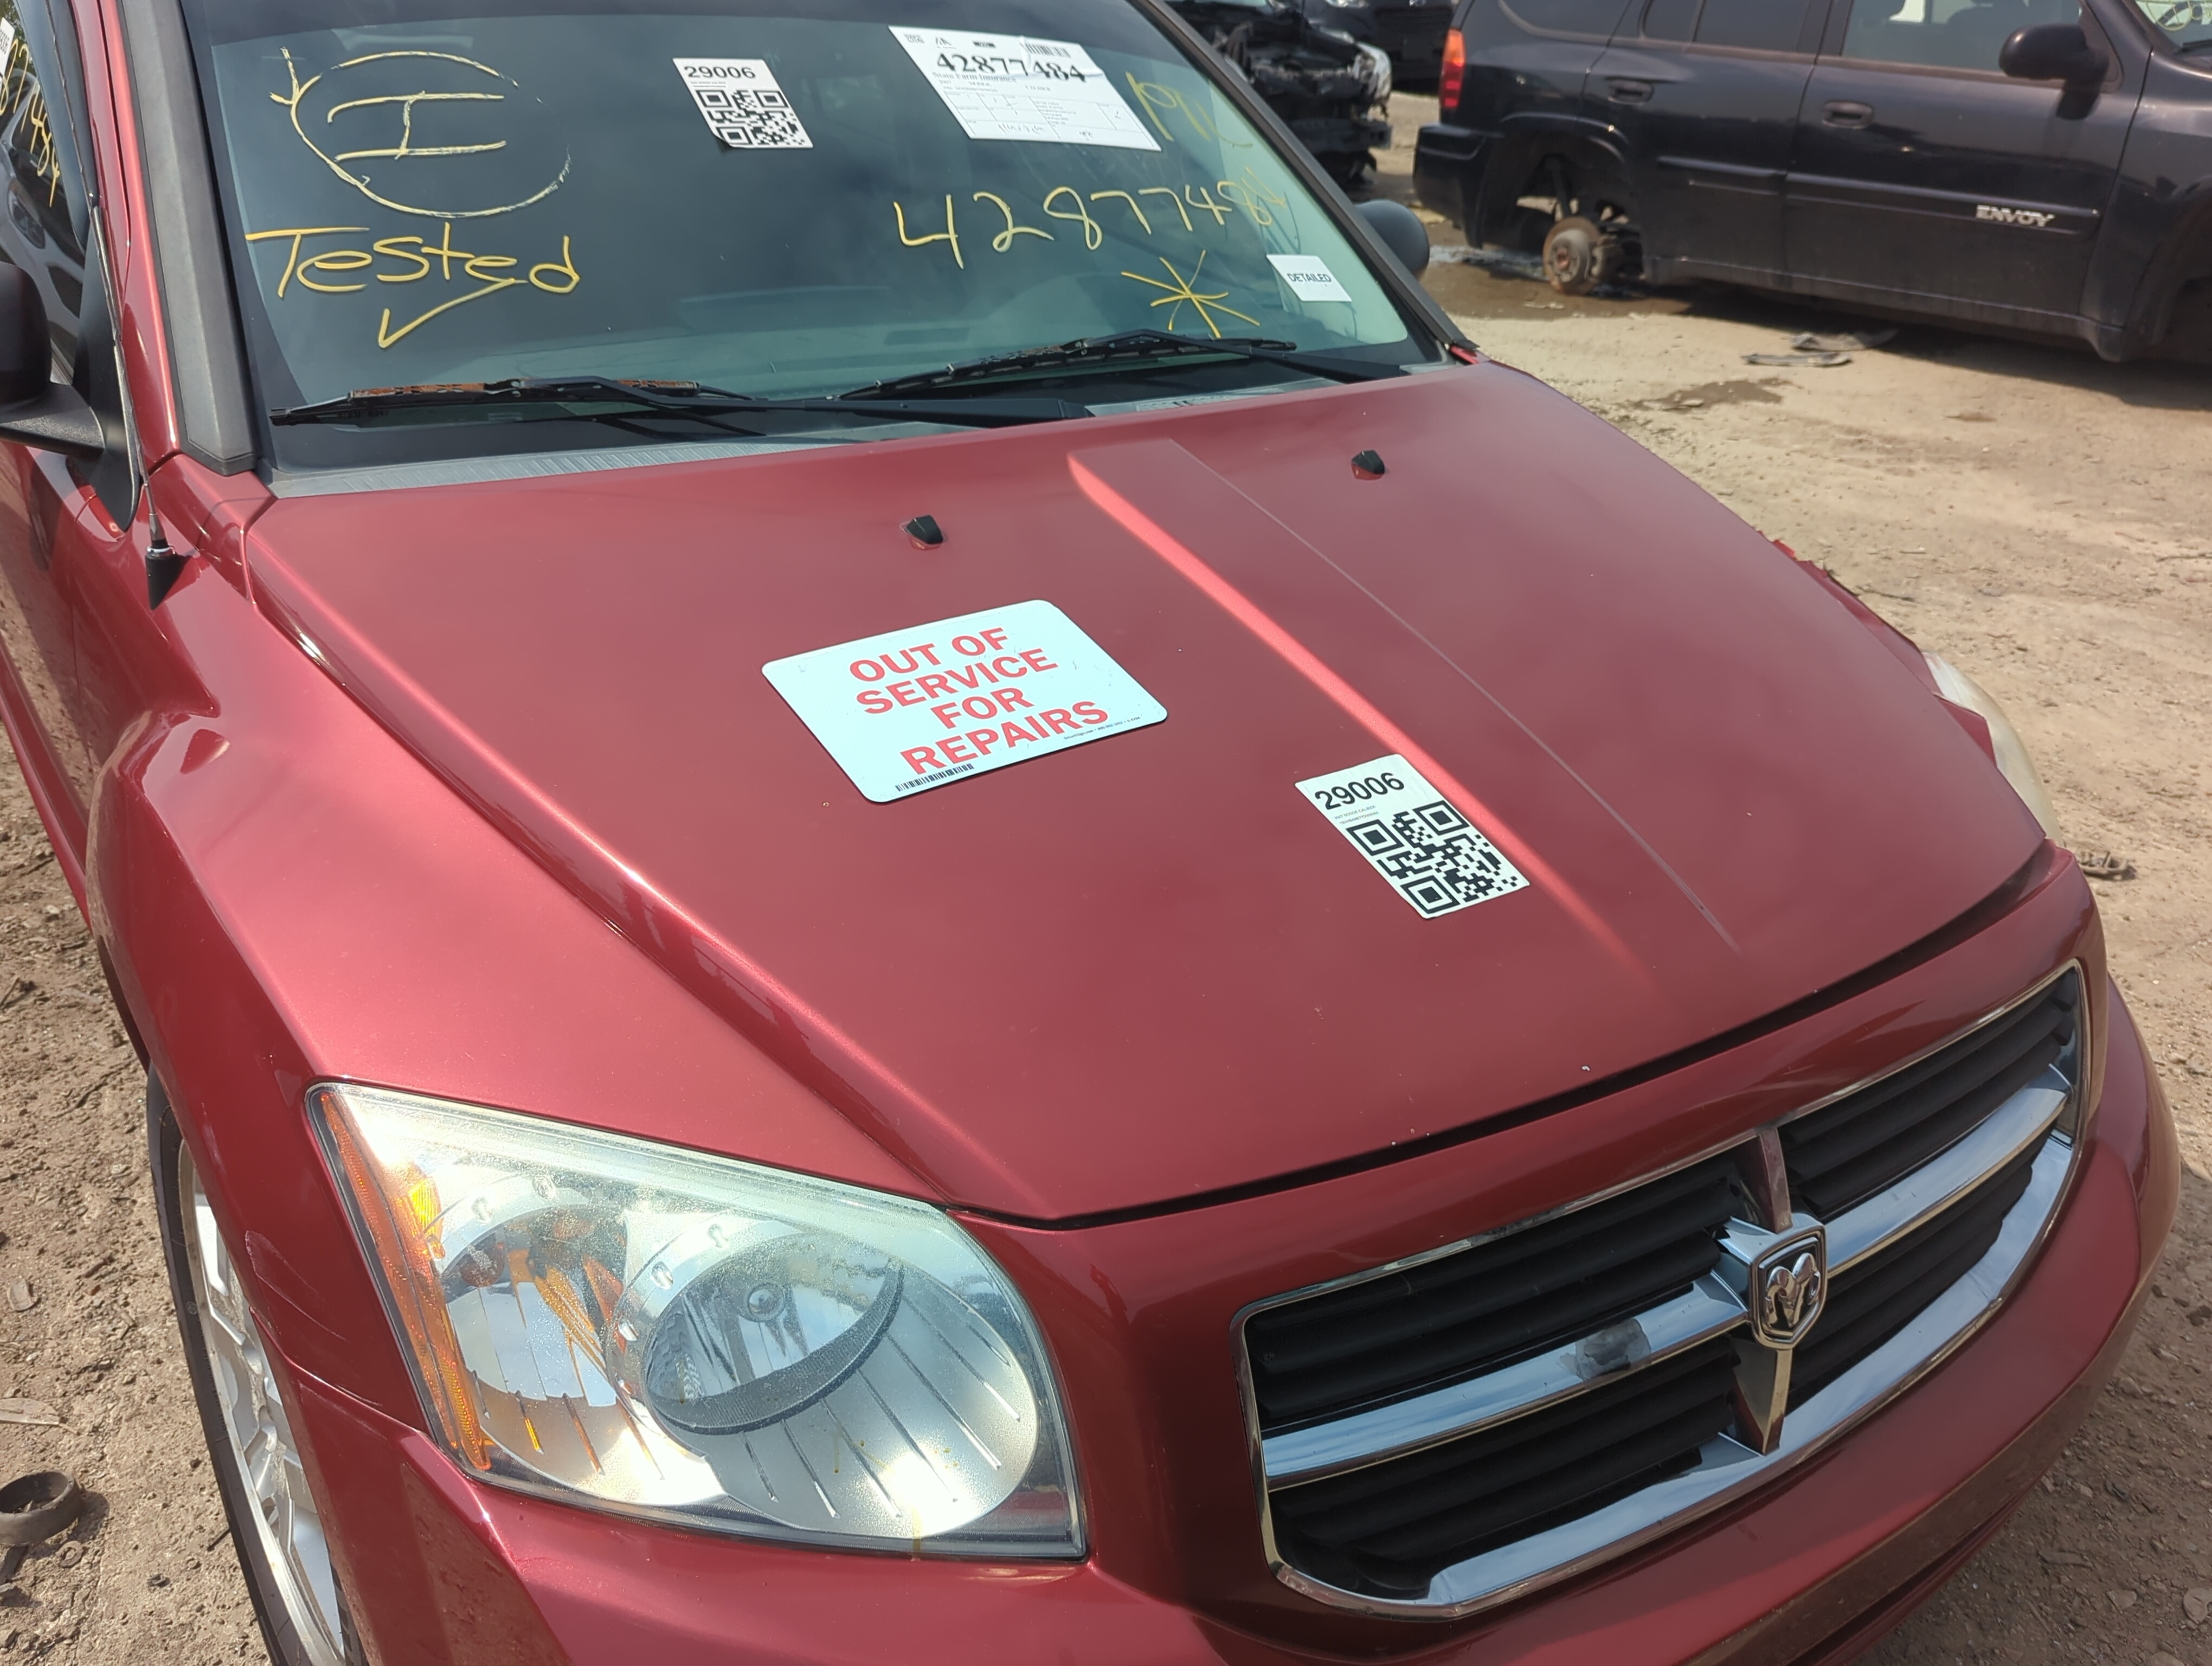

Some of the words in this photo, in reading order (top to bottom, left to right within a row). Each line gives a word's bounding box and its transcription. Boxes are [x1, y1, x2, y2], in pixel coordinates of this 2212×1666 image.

[684, 66, 756, 79] 29006
[936, 53, 1086, 82] 42877484
[956, 73, 978, 81] Farm
[980, 74, 1017, 82] Insurance
[1976, 204, 2056, 227] ENVOY
[246, 222, 581, 298] Tested
[1287, 273, 1332, 283] DETAILED
[850, 643, 942, 682] OUT
[951, 627, 1009, 657] OF
[856, 648, 1059, 715] SERVICE
[930, 687, 1035, 730] FOR
[899, 701, 1109, 775] REPAIRS
[1315, 772, 1405, 810] 29006
